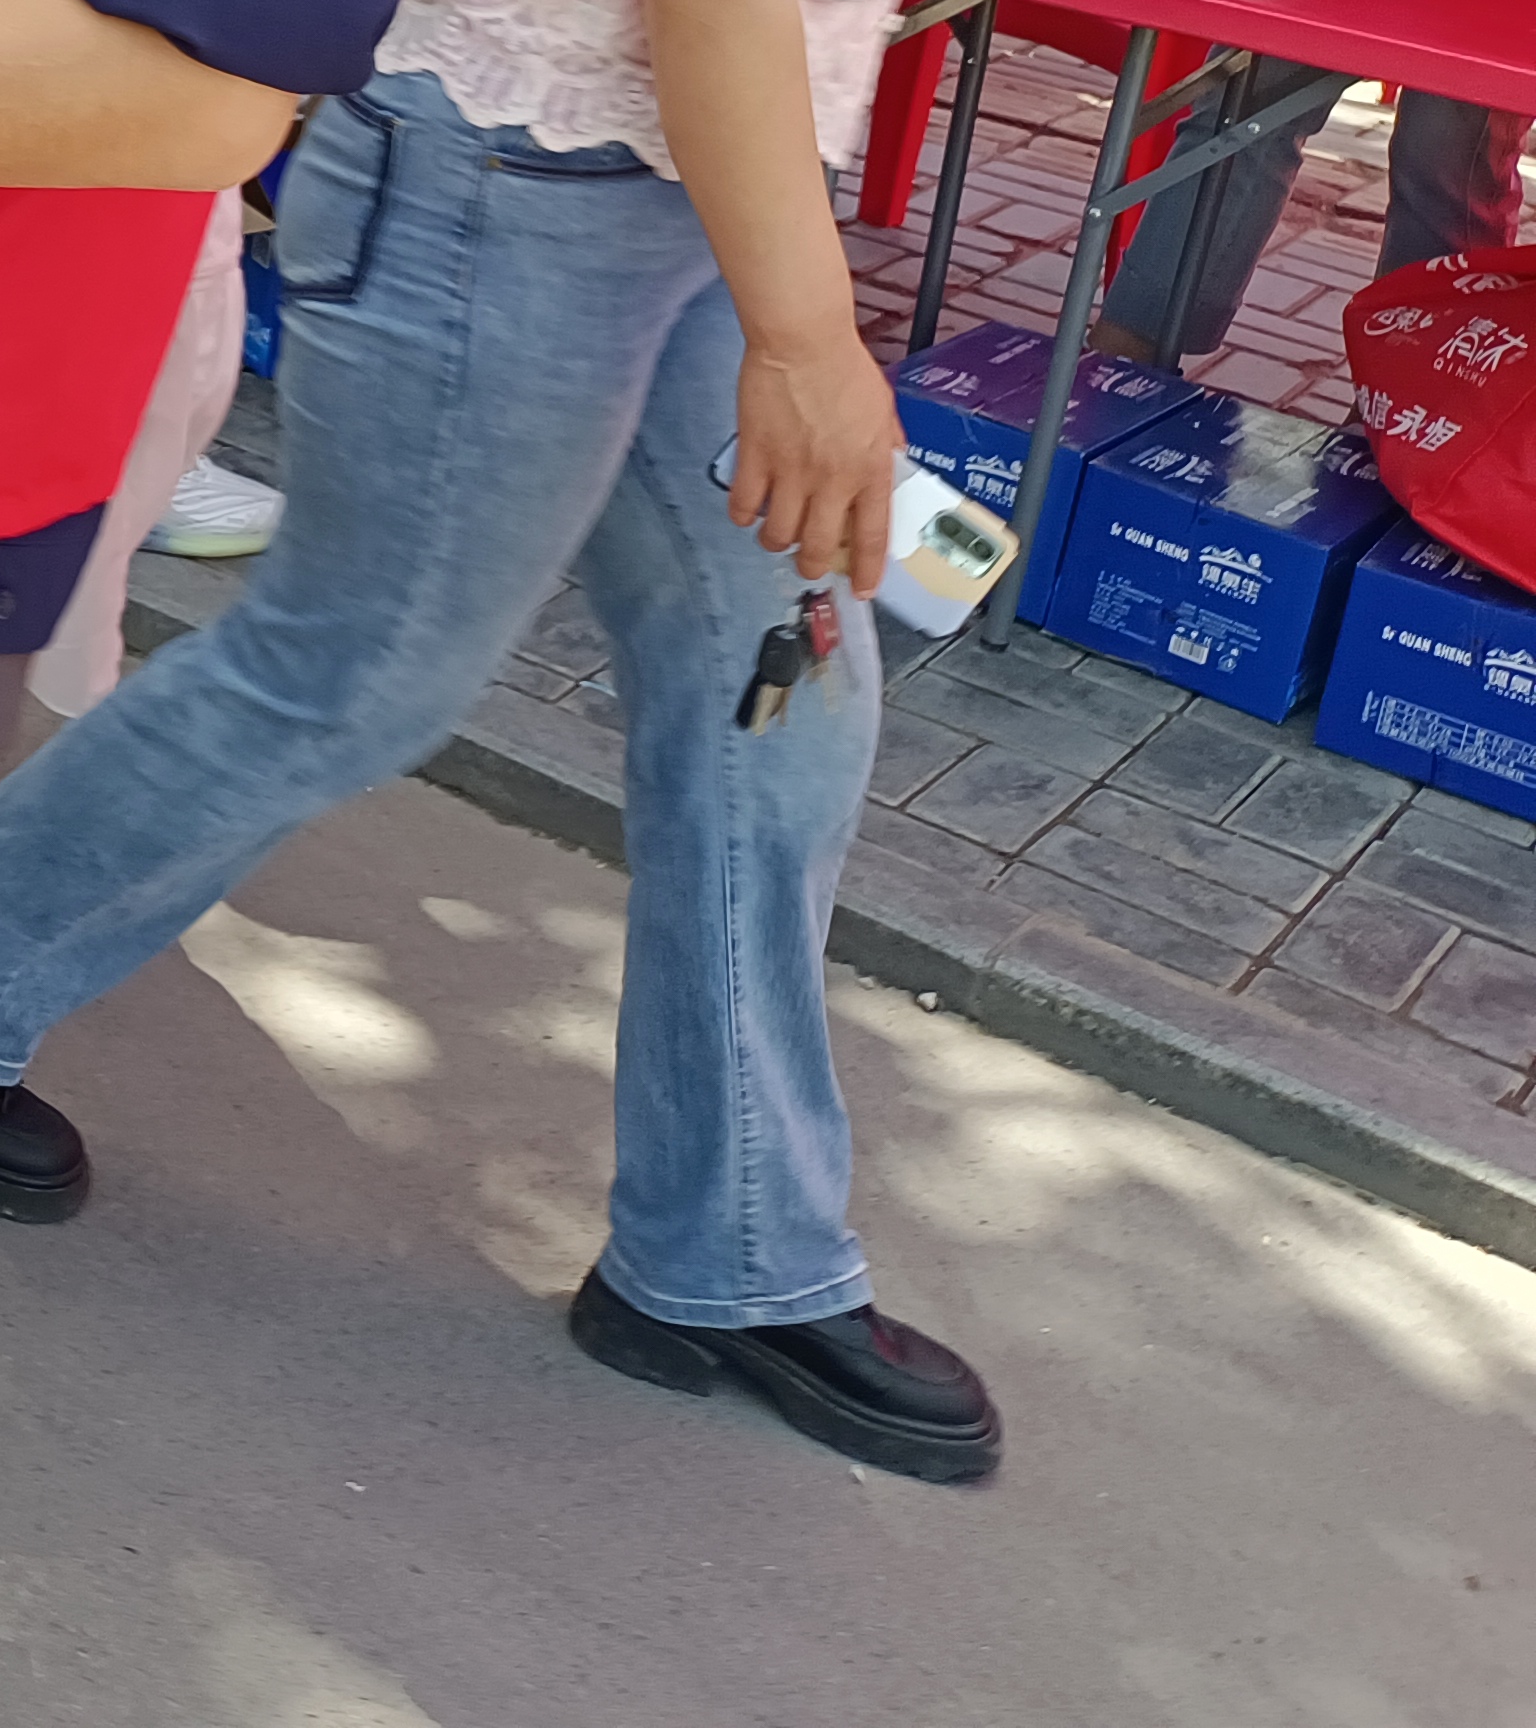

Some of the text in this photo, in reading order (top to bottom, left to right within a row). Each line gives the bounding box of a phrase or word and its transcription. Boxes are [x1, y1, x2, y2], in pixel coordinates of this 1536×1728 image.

[1125, 527, 1154, 549] QUAN
[1155, 539, 1190, 562] SHENG
[1399, 631, 1431, 653] QUAN
[1434, 643, 1472, 667] SHENG
